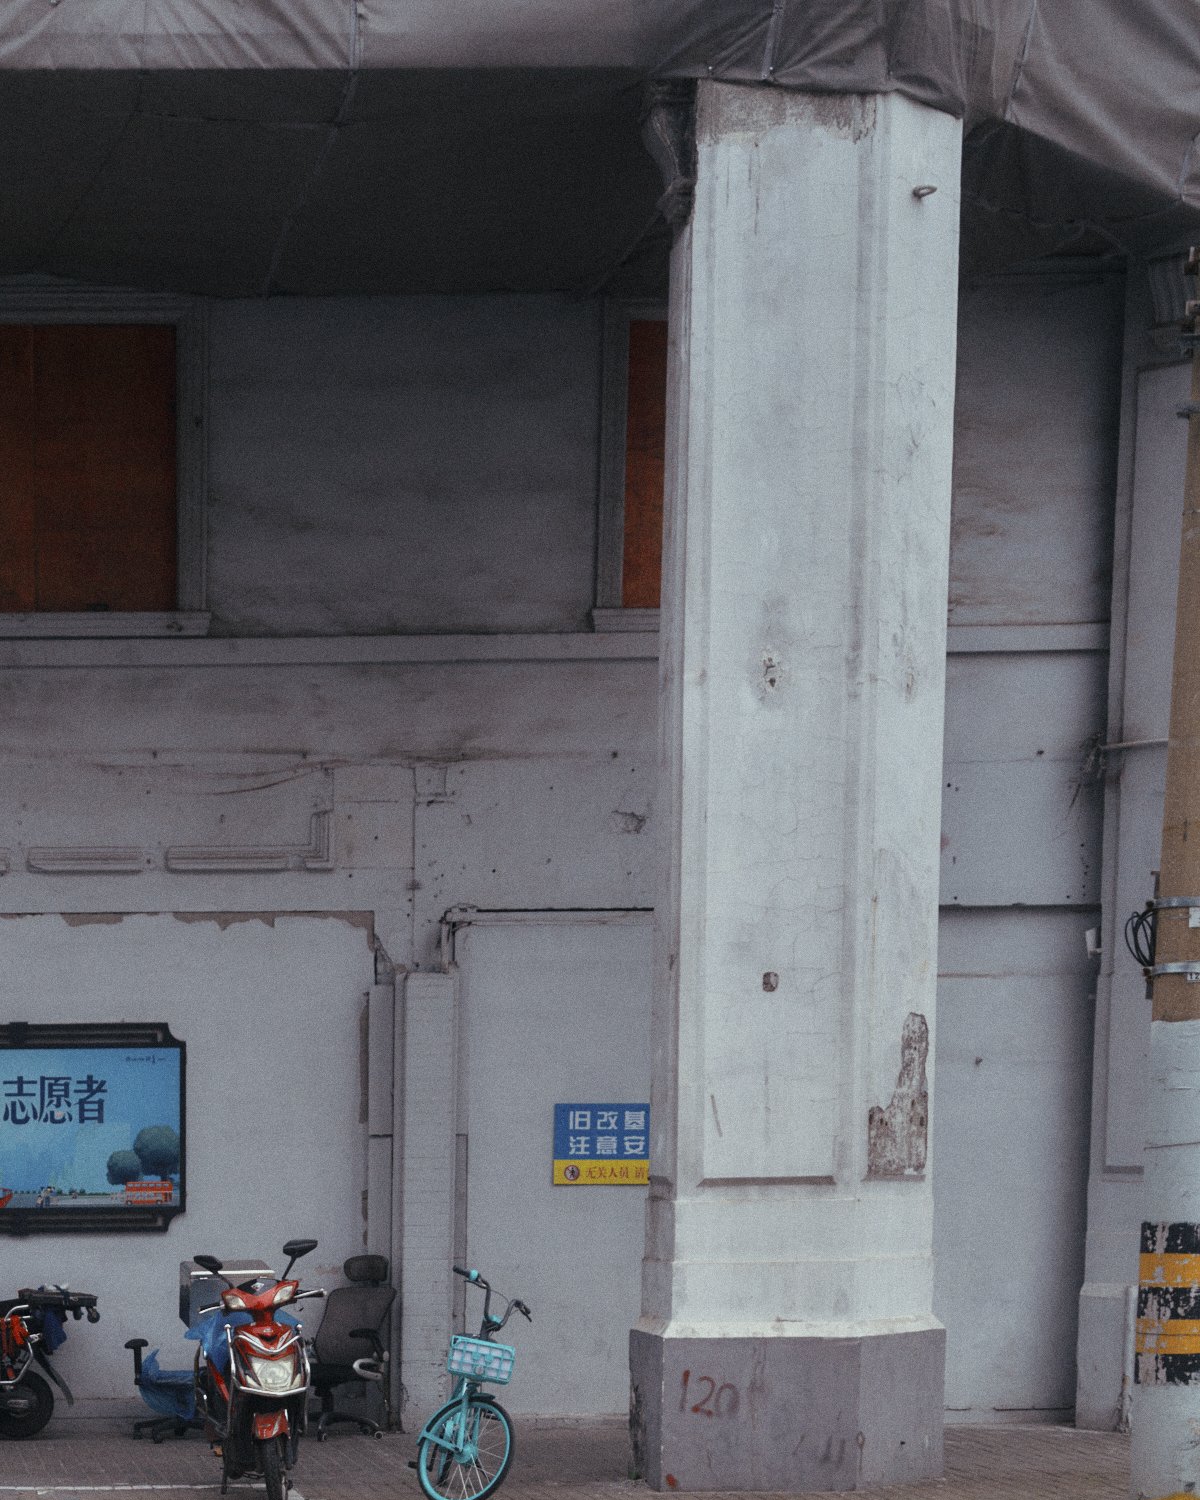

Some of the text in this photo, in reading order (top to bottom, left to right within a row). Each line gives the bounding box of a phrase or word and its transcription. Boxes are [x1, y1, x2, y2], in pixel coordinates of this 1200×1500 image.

[3, 1075, 107, 1125] 志愿者
[569, 1111, 645, 1130] 旧改基
[569, 1136, 645, 1155] 注意安
